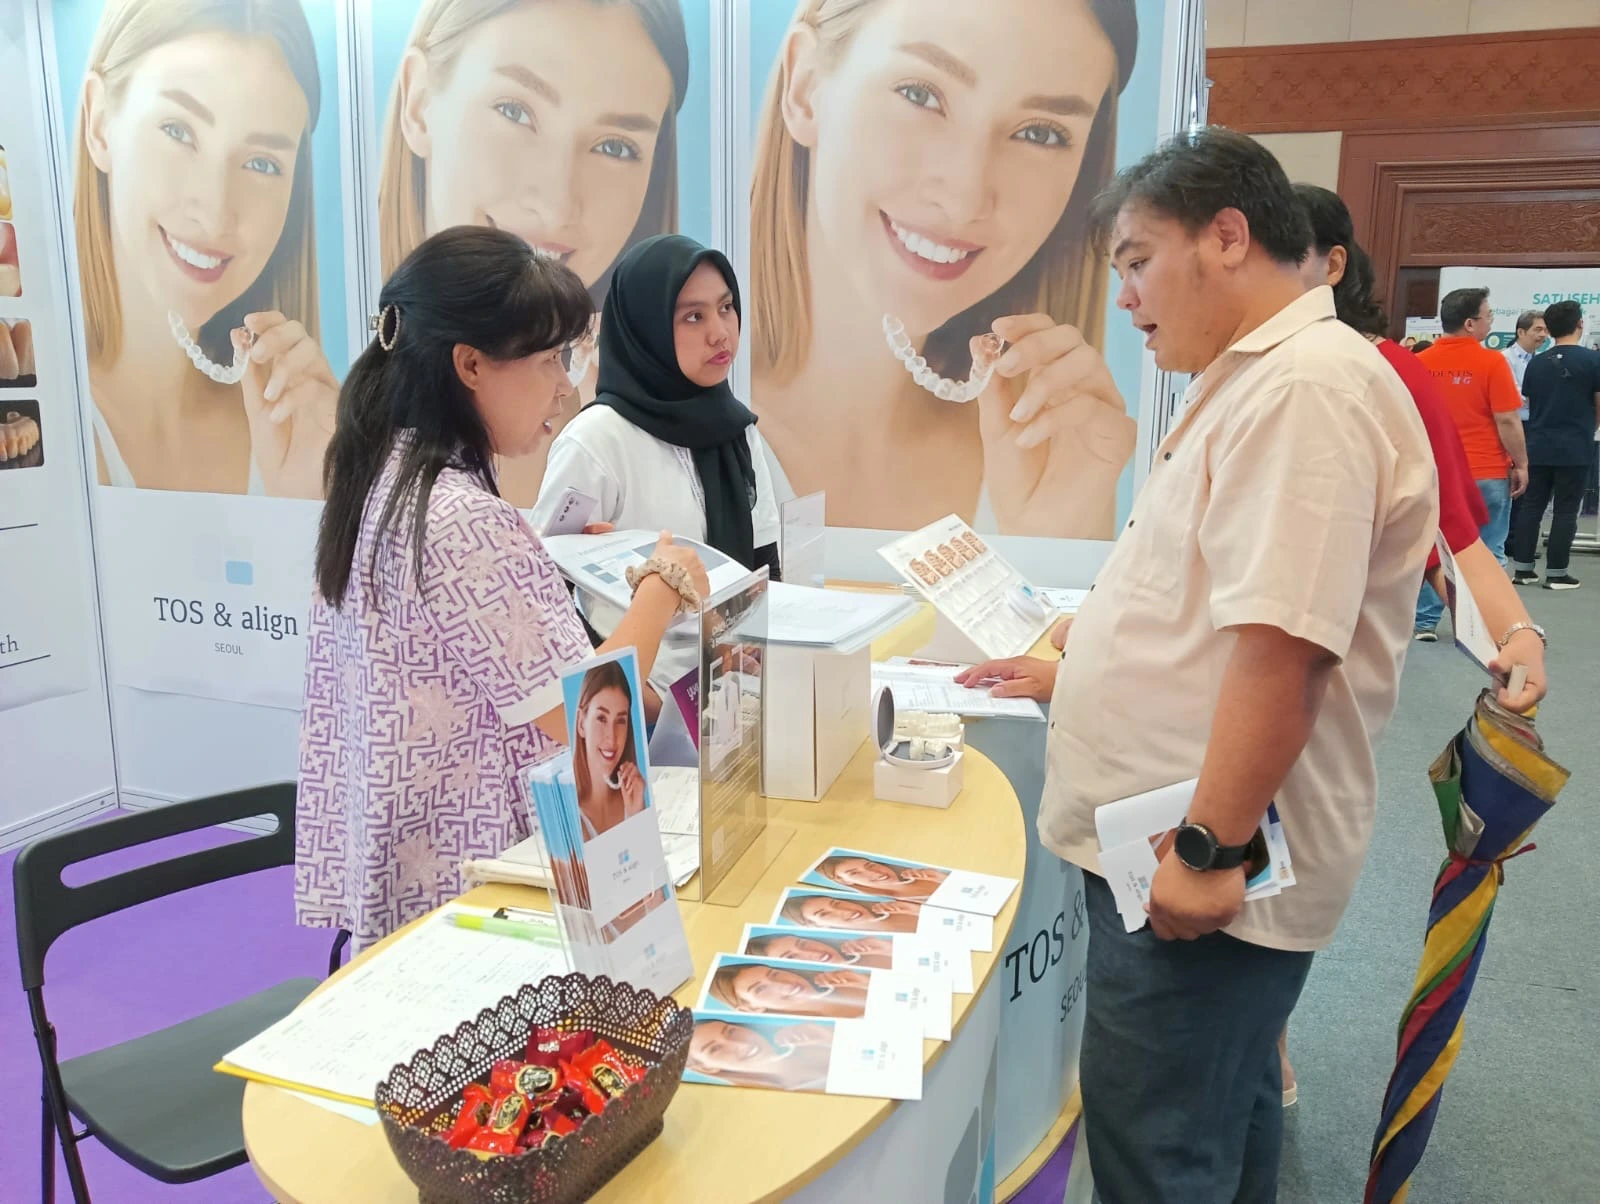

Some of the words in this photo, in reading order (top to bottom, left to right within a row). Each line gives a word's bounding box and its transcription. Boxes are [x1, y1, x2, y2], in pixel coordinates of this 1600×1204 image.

[153, 596, 204, 625] TOS
[213, 602, 233, 628] &
[241, 606, 299, 641] align
[214, 642, 244, 656] SEOUL
[1005, 911, 1065, 1003] TOS
[1071, 889, 1085, 941] &
